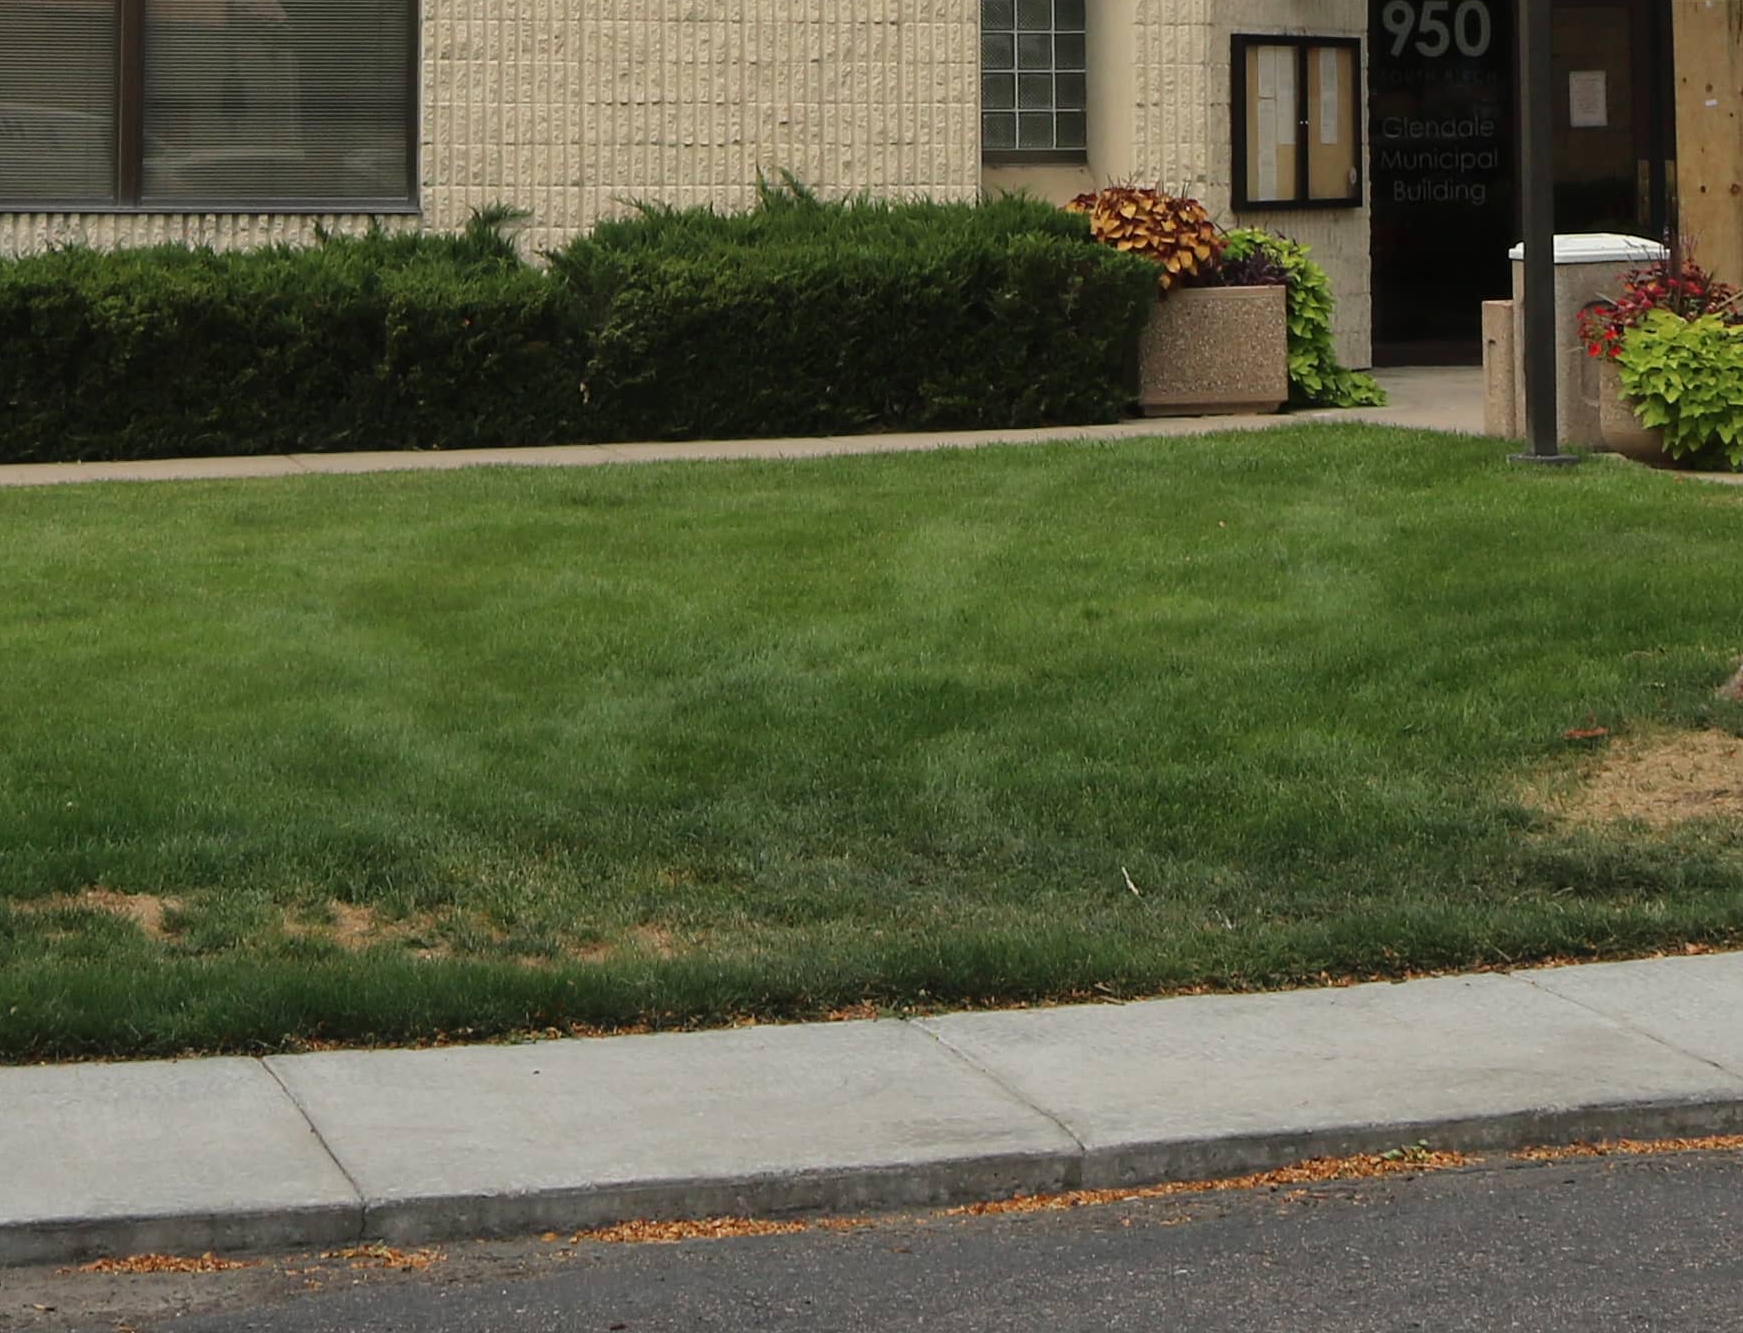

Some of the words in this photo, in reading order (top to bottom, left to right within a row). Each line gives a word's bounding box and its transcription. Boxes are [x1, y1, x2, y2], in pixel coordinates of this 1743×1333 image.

[1383, 115, 1495, 139] Glendale
[1379, 147, 1498, 174] Municipal
[1393, 178, 1486, 205] Building
